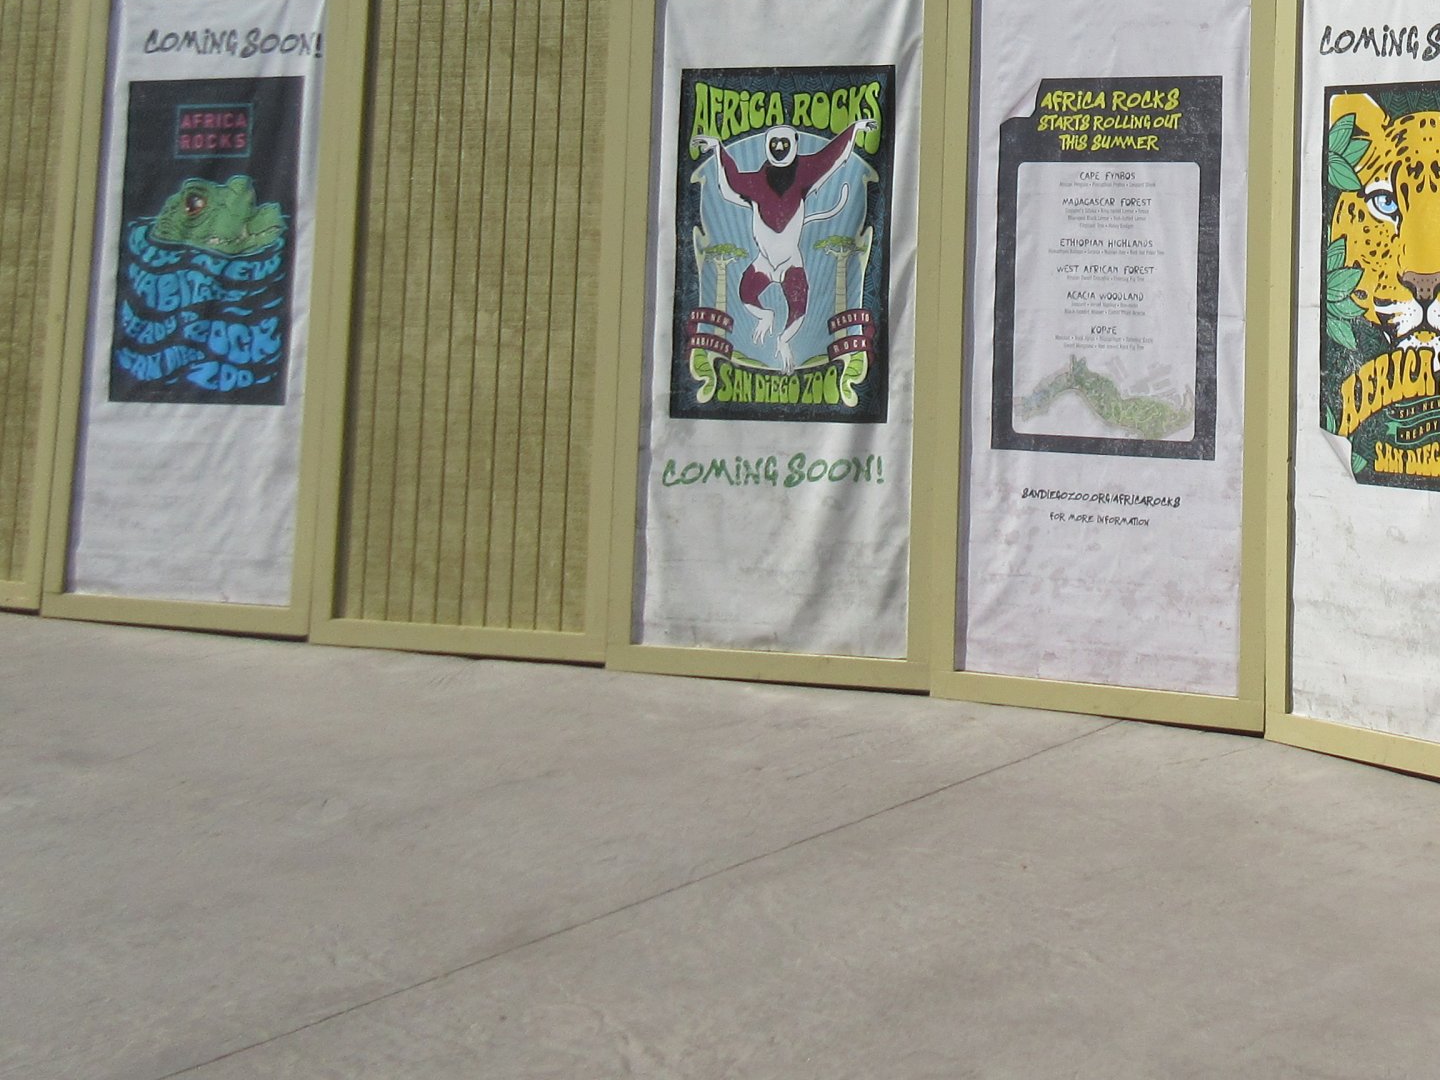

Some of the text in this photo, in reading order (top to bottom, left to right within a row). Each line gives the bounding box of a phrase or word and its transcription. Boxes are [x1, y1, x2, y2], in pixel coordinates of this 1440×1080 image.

[240, 27, 323, 58] SOON!
[1319, 24, 1418, 60] COMING
[1039, 87, 1181, 111] AFRICA ROCKS
[180, 113, 248, 130] AFRICA
[689, 81, 882, 161] AFRICA ROCKS
[1037, 112, 1183, 132] STARTS ROLLING OUT
[179, 133, 247, 150] ROCKS
[1058, 134, 1160, 152] THIS SUMMER
[1079, 171, 1100, 181] CAPE
[1062, 197, 1152, 207] MADAGASCAR FOREST
[1059, 238, 1104, 248] ETHIOPIAN
[1056, 264, 1155, 275] WEST AFRICAN FOREST
[1066, 290, 1144, 302] ACACIA WOODLAND
[690, 311, 706, 321] SIX
[859, 312, 871, 323] TO
[832, 339, 868, 353] ROCK
[717, 363, 840, 404] SAN DIEGO ZOO
[1338, 348, 1436, 437] AFRICA
[1374, 440, 1404, 473] SAN
[783, 452, 885, 488] SOON!
[1049, 511, 1151, 527] FOR MORE INFORMATION
